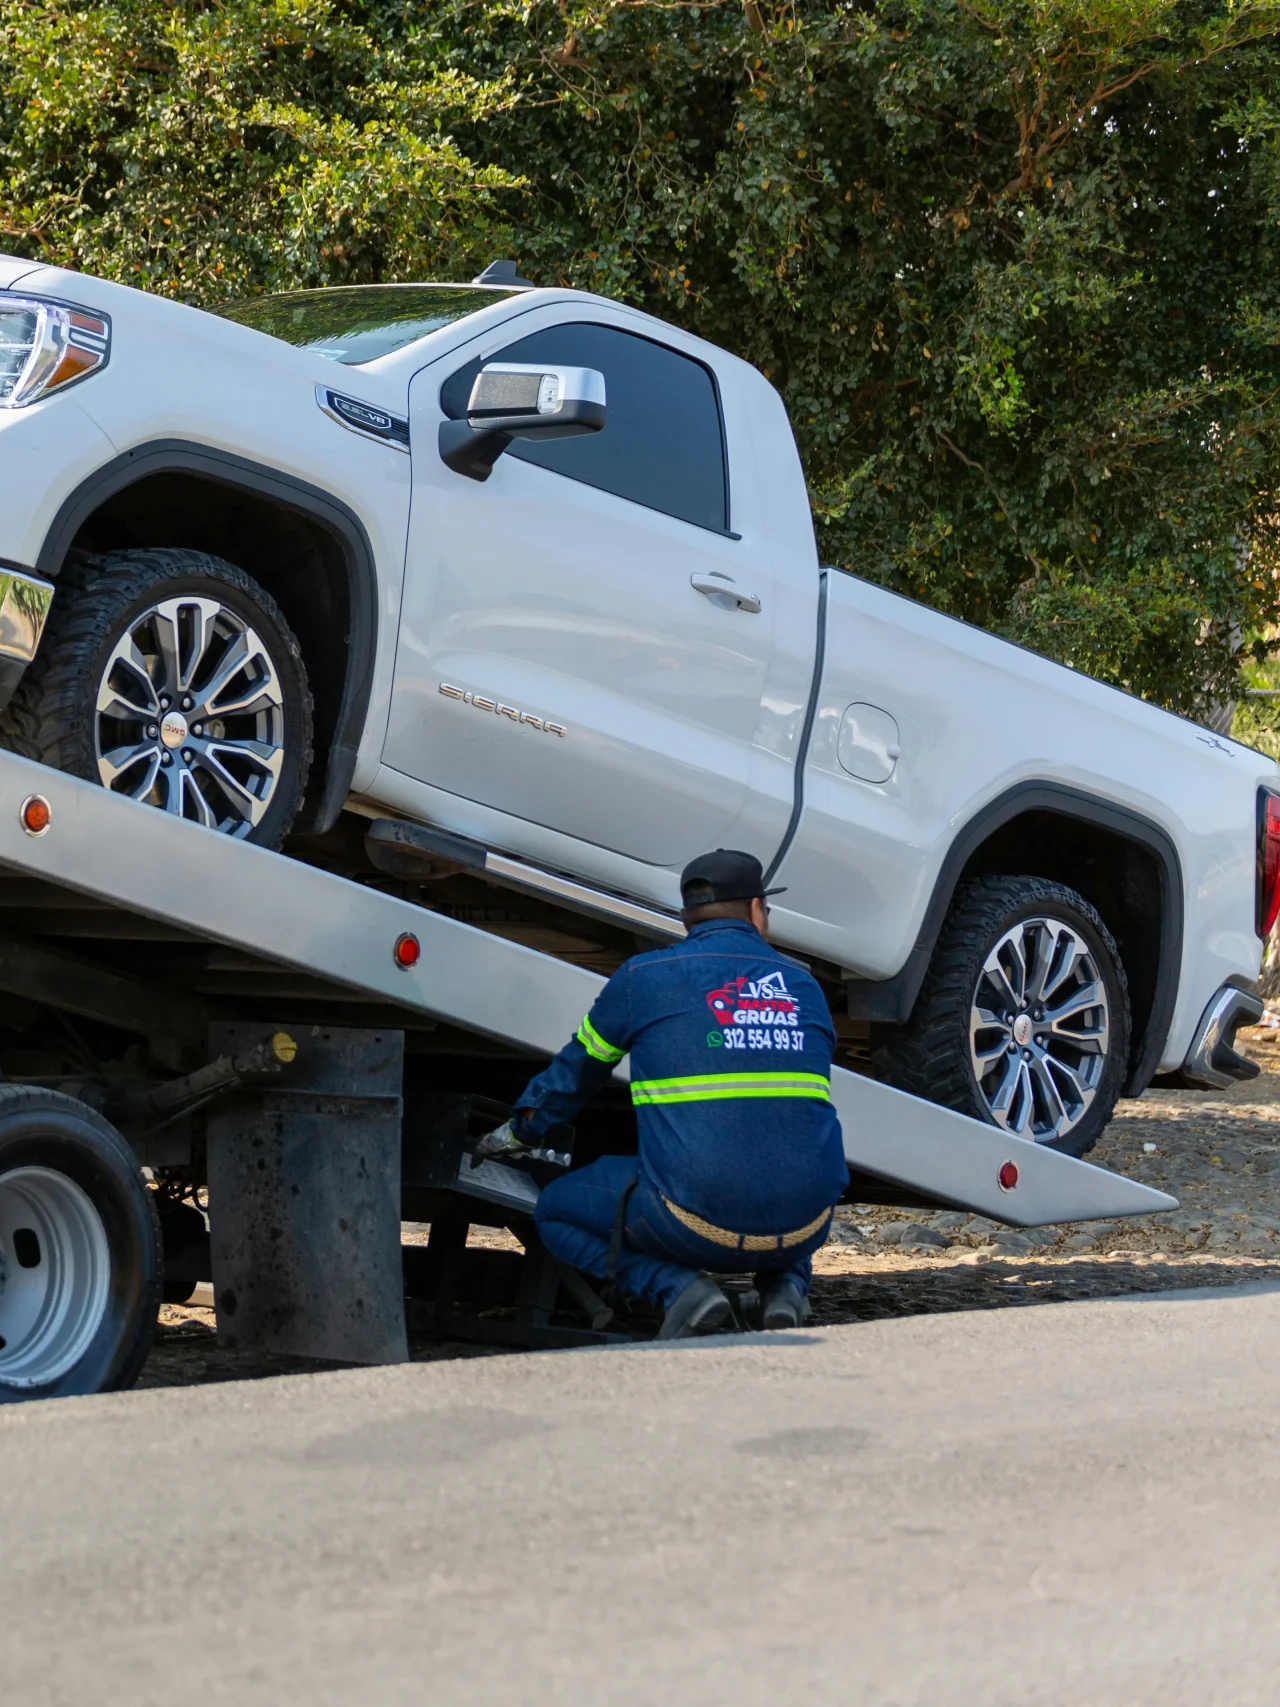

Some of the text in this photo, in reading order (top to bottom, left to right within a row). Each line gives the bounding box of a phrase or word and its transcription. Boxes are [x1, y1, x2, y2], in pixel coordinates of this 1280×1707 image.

[439, 682, 567, 737] SIERRA
[164, 723, 186, 737] GMC
[748, 982, 774, 999] VS
[732, 1007, 799, 1026] GRÚAS
[723, 1028, 805, 1051] 312 554 99 37
